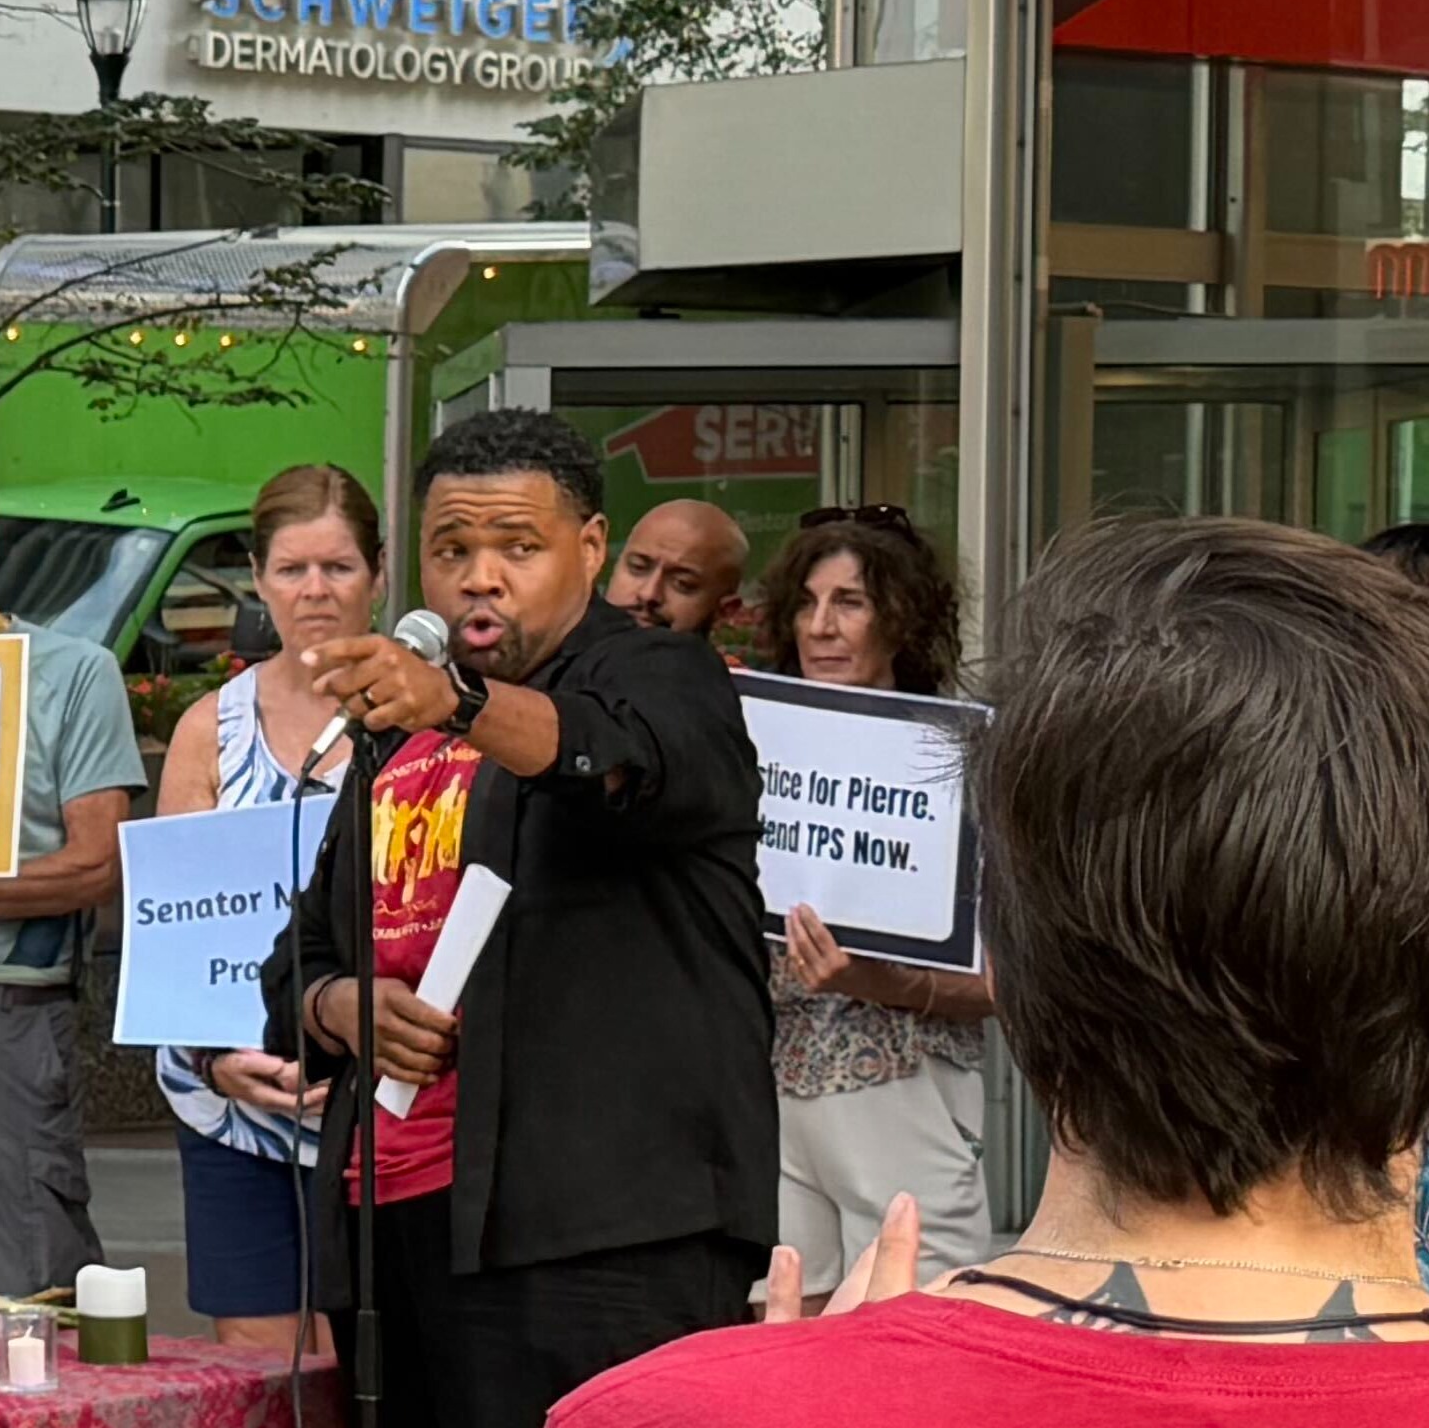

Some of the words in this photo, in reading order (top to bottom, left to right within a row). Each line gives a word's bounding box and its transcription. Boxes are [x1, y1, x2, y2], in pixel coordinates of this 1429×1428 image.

[206, 31, 469, 84] DERMATOLOGY
[692, 404, 818, 461] SERV
[759, 761, 802, 800] tice
[809, 771, 841, 806] for
[847, 777, 935, 821] Pierre.
[807, 823, 844, 860] TPS
[854, 831, 917, 872] Now.
[137, 889, 262, 925] Senator
